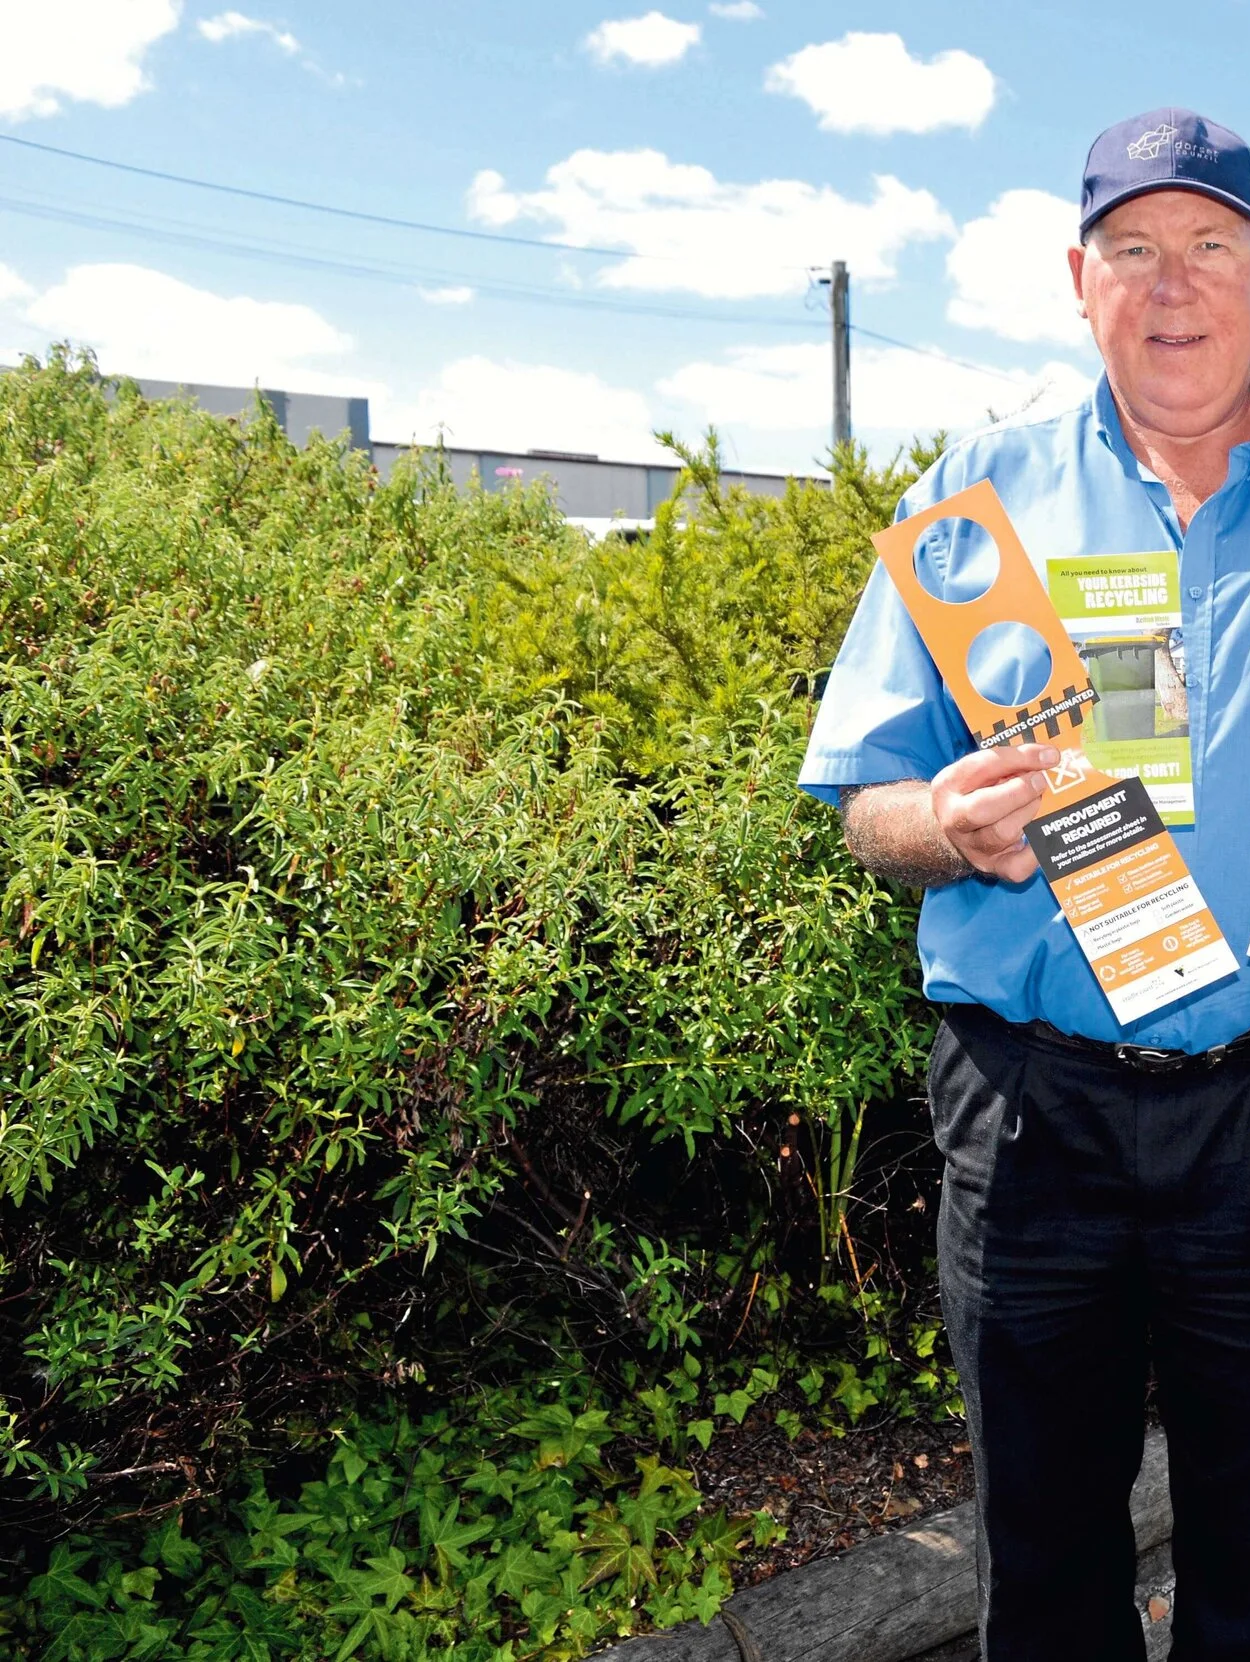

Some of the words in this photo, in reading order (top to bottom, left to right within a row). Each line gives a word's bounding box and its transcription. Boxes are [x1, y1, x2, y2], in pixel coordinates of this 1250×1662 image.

[1175, 149, 1219, 164] COUNCIL
[1077, 576, 1110, 592] YOUR
[1110, 573, 1167, 590] KERBSIDE
[1083, 568, 1100, 576] need
[1084, 588, 1168, 609] RECYCLING
[980, 721, 1028, 749] CONTENTS
[1026, 688, 1095, 727] CONTAMINATED
[1143, 762, 1180, 778] SORT!
[1041, 789, 1127, 836] IMPROVEMENT
[1061, 811, 1122, 845] REQUIRED
[1050, 851, 1068, 863] Refer
[1068, 848, 1076, 856] to
[1075, 844, 1087, 853] the
[1086, 827, 1123, 848] assessment
[1122, 818, 1141, 832] sheet
[1140, 815, 1148, 823] in
[1057, 857, 1072, 870] your
[1072, 847, 1097, 863] mailbox
[1096, 842, 1106, 852] for
[1105, 835, 1123, 847] more
[1089, 922, 1104, 933] NOT
[1105, 906, 1139, 926] SUITABLE
[1137, 899, 1154, 912] FOR
[1151, 882, 1190, 905] RECYCLING
